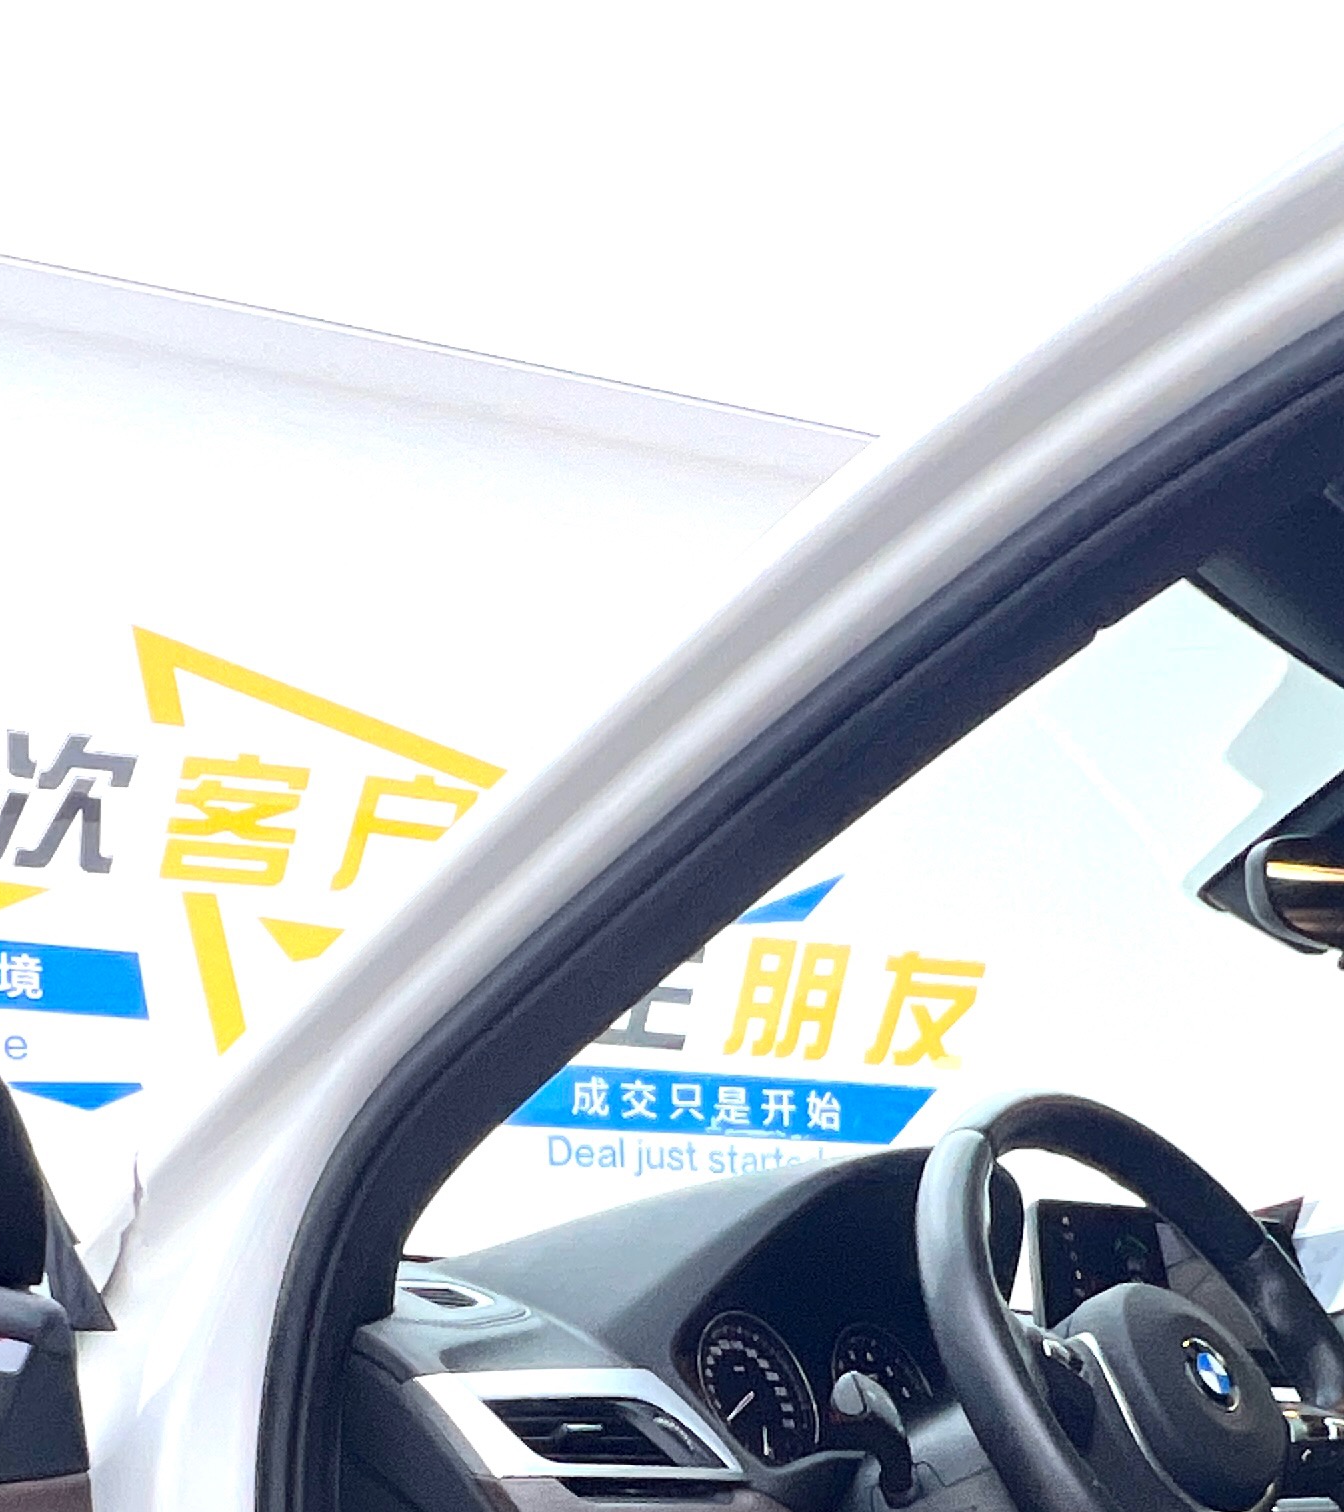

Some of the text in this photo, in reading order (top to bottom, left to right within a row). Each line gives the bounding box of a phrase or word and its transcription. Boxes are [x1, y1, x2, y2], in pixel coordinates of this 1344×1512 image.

[571, 1075, 842, 1132] 成交只是开始
[548, 1135, 626, 1168] Deal
[634, 1138, 698, 1177] just
